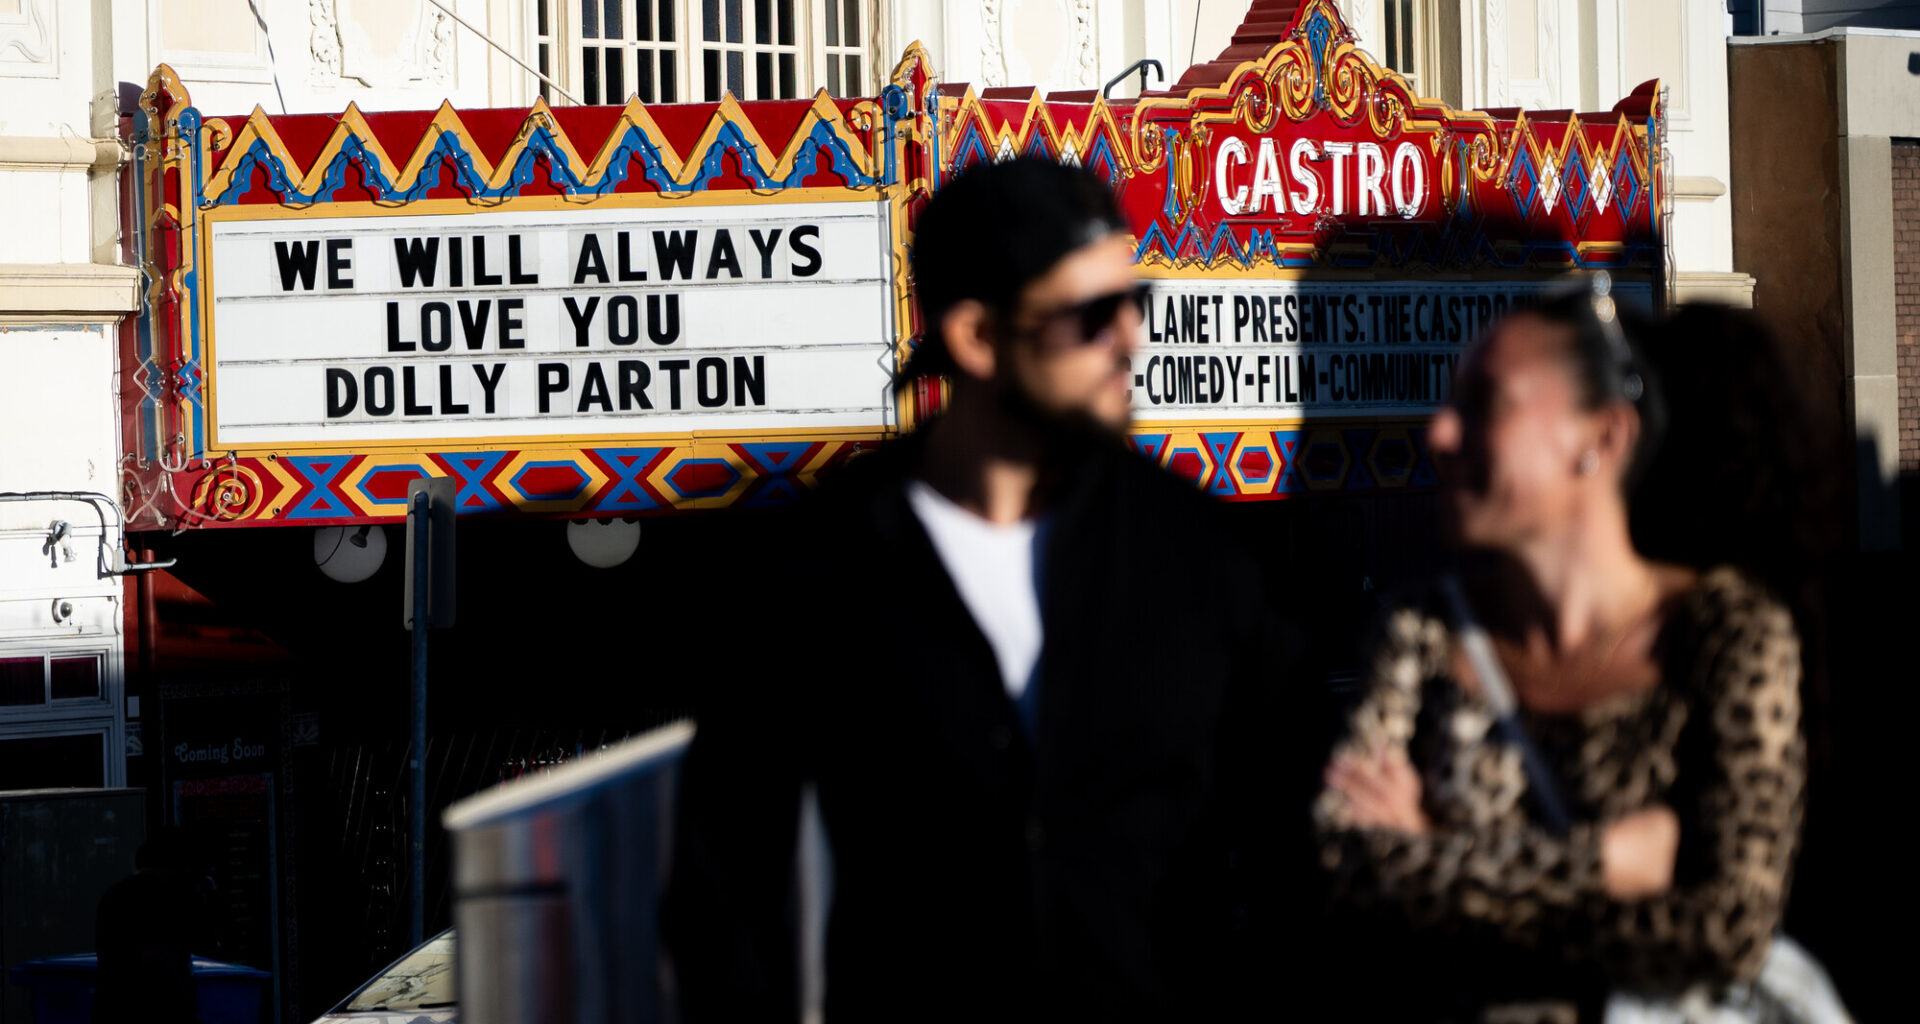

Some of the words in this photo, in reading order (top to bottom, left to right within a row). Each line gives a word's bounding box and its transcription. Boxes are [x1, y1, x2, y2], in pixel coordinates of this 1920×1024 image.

[1215, 136, 1426, 219] CASTRO
[274, 238, 354, 292] WE
[394, 234, 539, 288] WILL
[573, 225, 823, 285] ALWAYS
[386, 298, 525, 353] LOVE
[562, 293, 681, 347] YOU
[1146, 294, 1223, 344] LANET
[326, 362, 507, 418] DOLLY
[538, 355, 766, 414] PARTON
[174, 740, 230, 765] Coming
[231, 737, 265, 761] Soon
